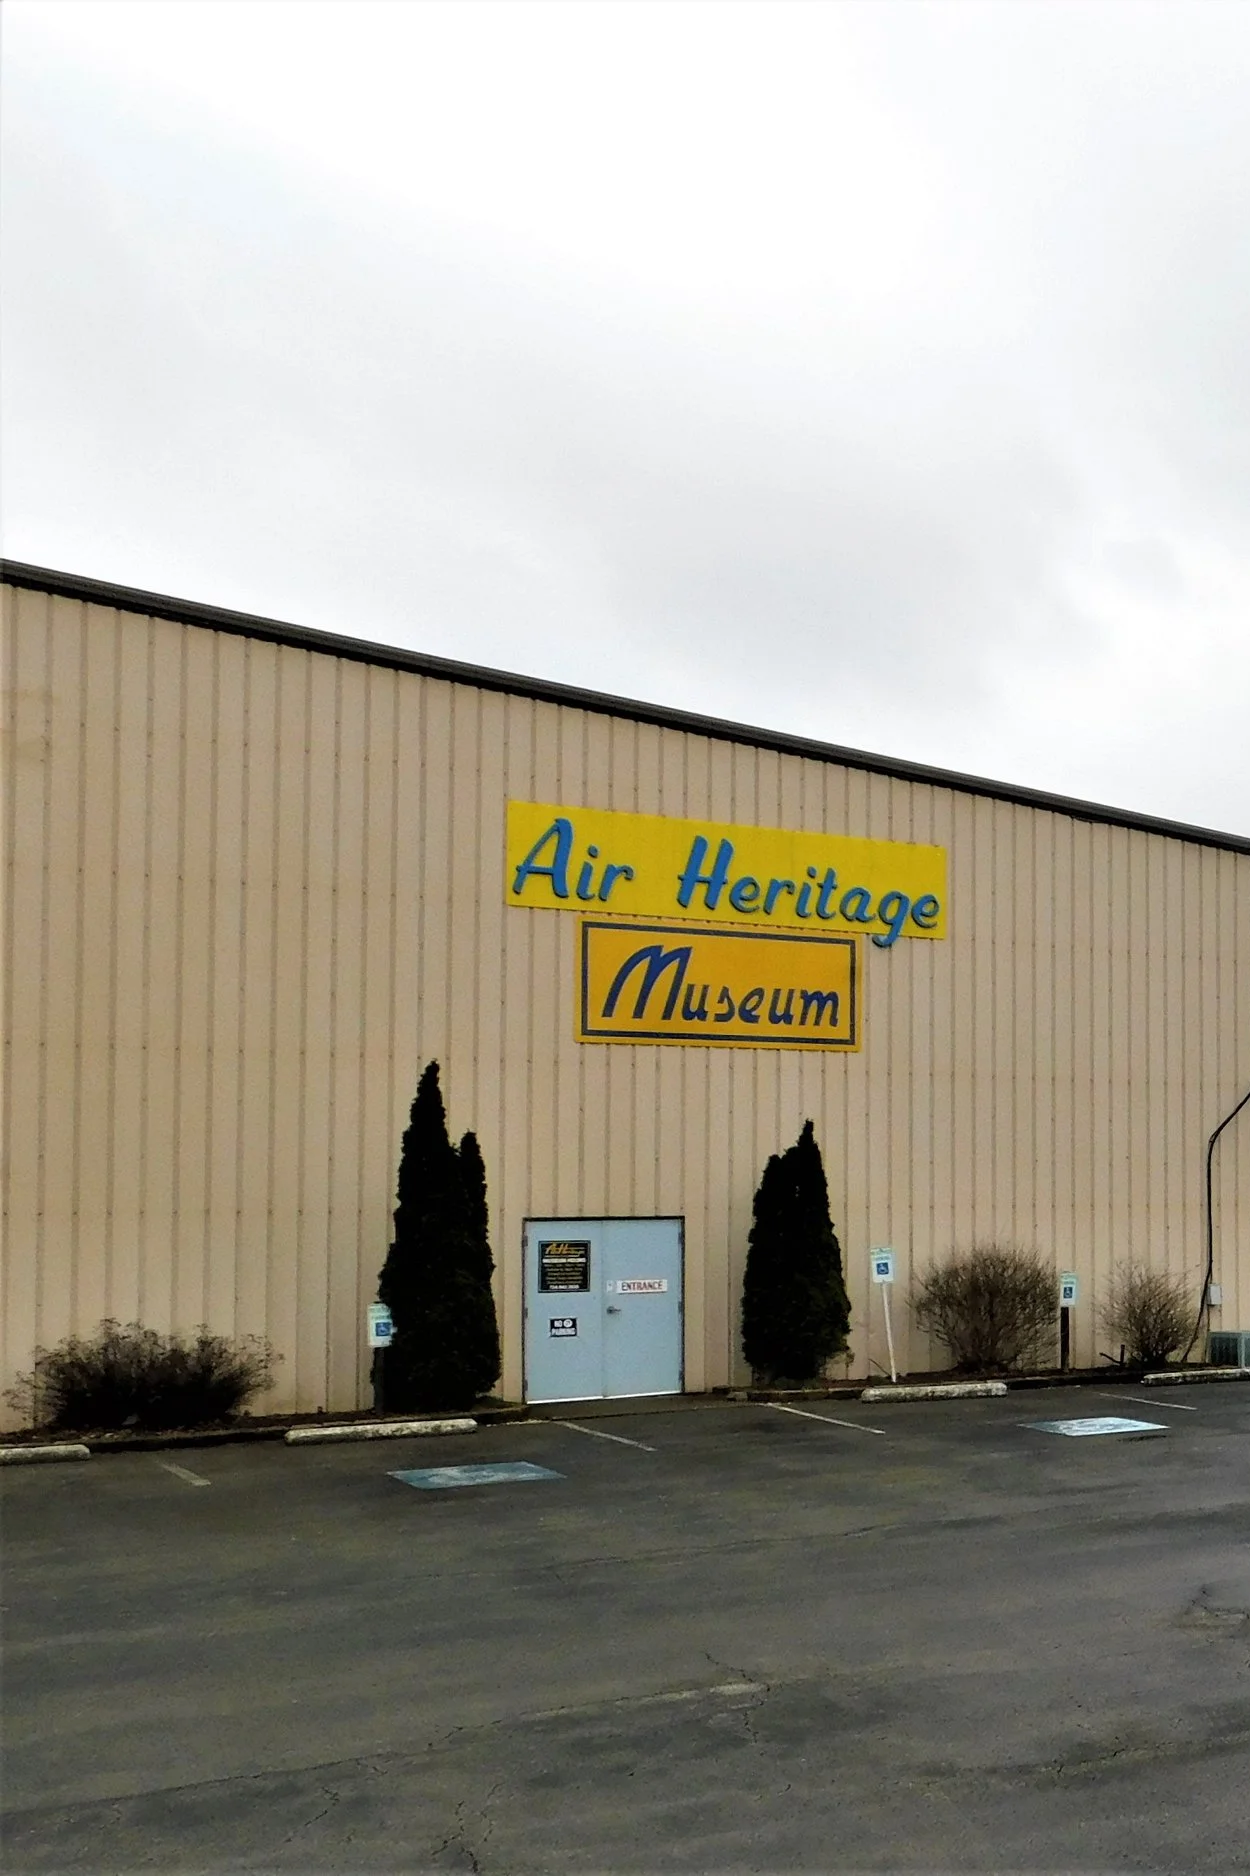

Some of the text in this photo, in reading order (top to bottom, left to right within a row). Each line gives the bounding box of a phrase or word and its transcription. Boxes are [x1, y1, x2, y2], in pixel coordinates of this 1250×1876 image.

[511, 818, 940, 947] Air Heritage
[600, 944, 840, 1028] Museum
[621, 1281, 663, 1291] ENTRANCE
